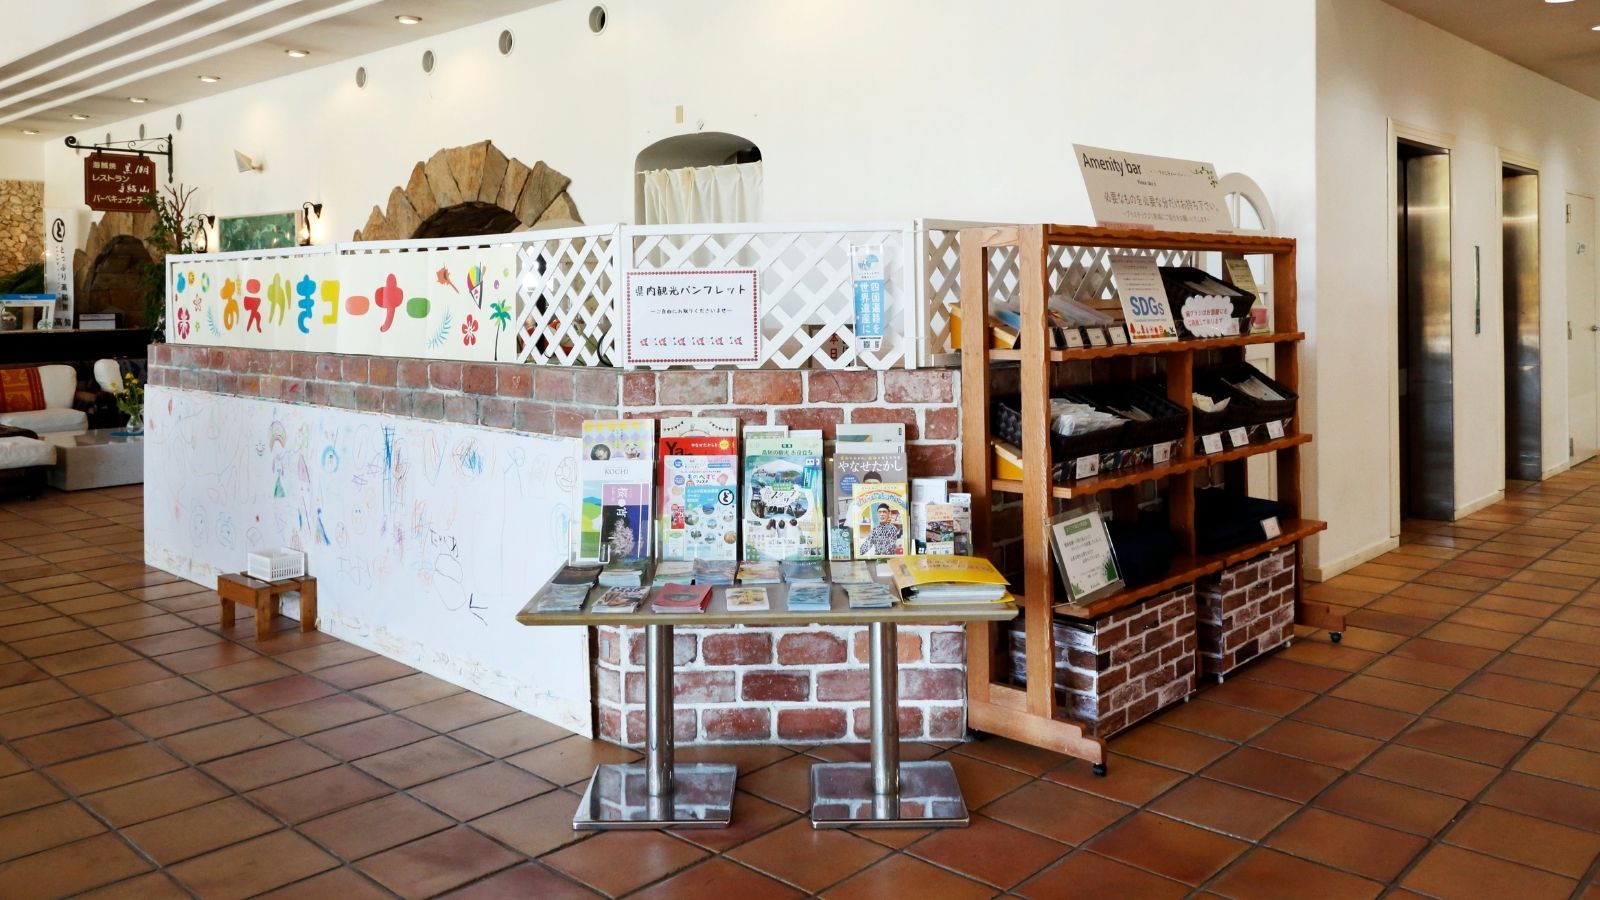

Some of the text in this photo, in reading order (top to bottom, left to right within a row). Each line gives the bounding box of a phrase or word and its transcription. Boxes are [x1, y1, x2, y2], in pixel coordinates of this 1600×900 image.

[1082, 152, 1142, 176] Amenity bar
[92, 174, 130, 182] レストラン
[92, 194, 149, 204] バーベキューガーデ
[635, 284, 746, 296] 県内観光パンフレット
[220, 272, 431, 334] おえかきコーナー
[860, 281, 871, 334] 世界遺産に
[870, 282, 880, 334] 四国遍路を
[1129, 295, 1165, 316] SDGs
[838, 460, 904, 473] やなせたかし
